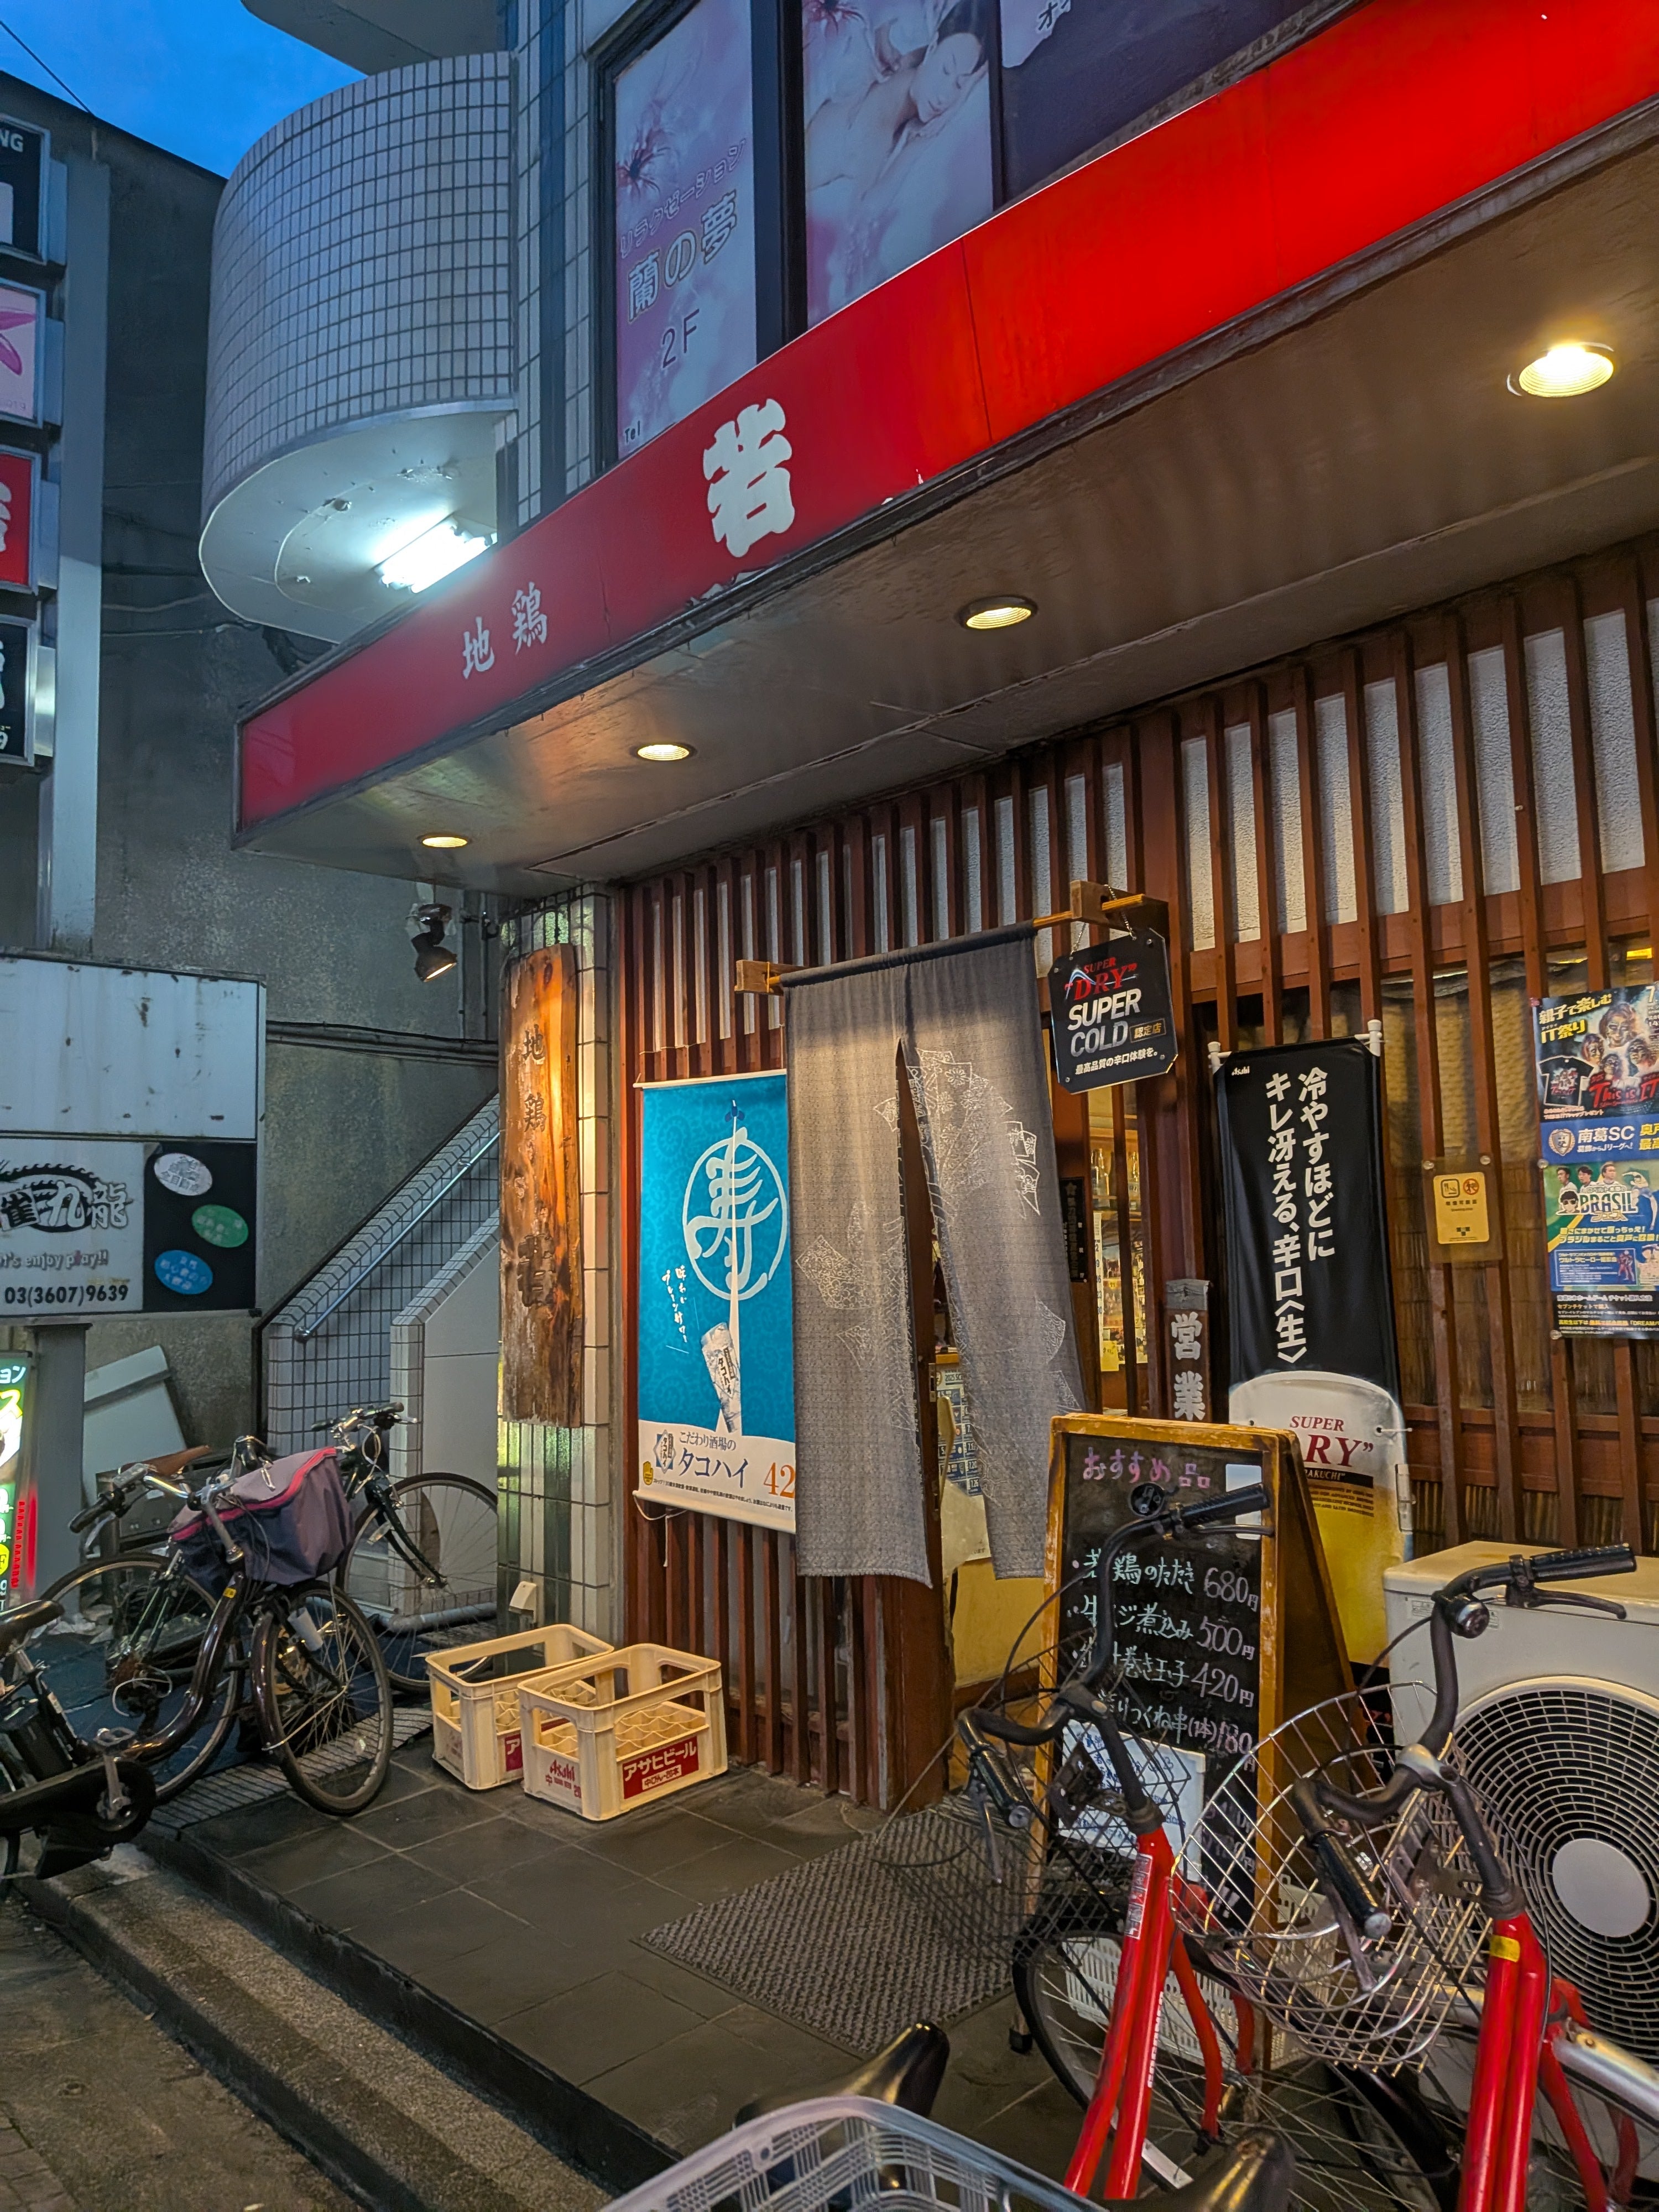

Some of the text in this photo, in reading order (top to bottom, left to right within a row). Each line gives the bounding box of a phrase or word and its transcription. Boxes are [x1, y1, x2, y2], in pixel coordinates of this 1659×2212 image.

[628, 190, 738, 323] 蘭の夢
[661, 310, 701, 369] 2F
[461, 581, 548, 680] 地鶏
[1067, 988, 1142, 1031] SUPER
[1539, 994, 1613, 1024] 親子で楽しむ
[1071, 1020, 1162, 1057] COLD 認定店
[1541, 1019, 1585, 1044] IT祭り
[1074, 1047, 1158, 1076] 最高品質の辛口体験を。
[1231, 1066, 1250, 1076] Asahi
[1578, 1125, 1635, 1144] 南葛SC
[1298, 1066, 1335, 1262] 冷やすほどに
[1580, 1192, 1638, 1213] BRASIL
[4, 1285, 129, 1308] 03(3607)9639
[1171, 1311, 1206, 1421] 営業
[679, 1431, 737, 1451] こだわり酒場の
[1290, 1416, 1344, 1432] SUPER
[678, 1447, 749, 1489] タコハイ
[1082, 1446, 1211, 1490] おすすめ品
[1081, 1594, 1194, 1640] 牛ジ煮込み
[550, 1759, 575, 1782] Asahi
[624, 1741, 697, 1782] アサヒビール
